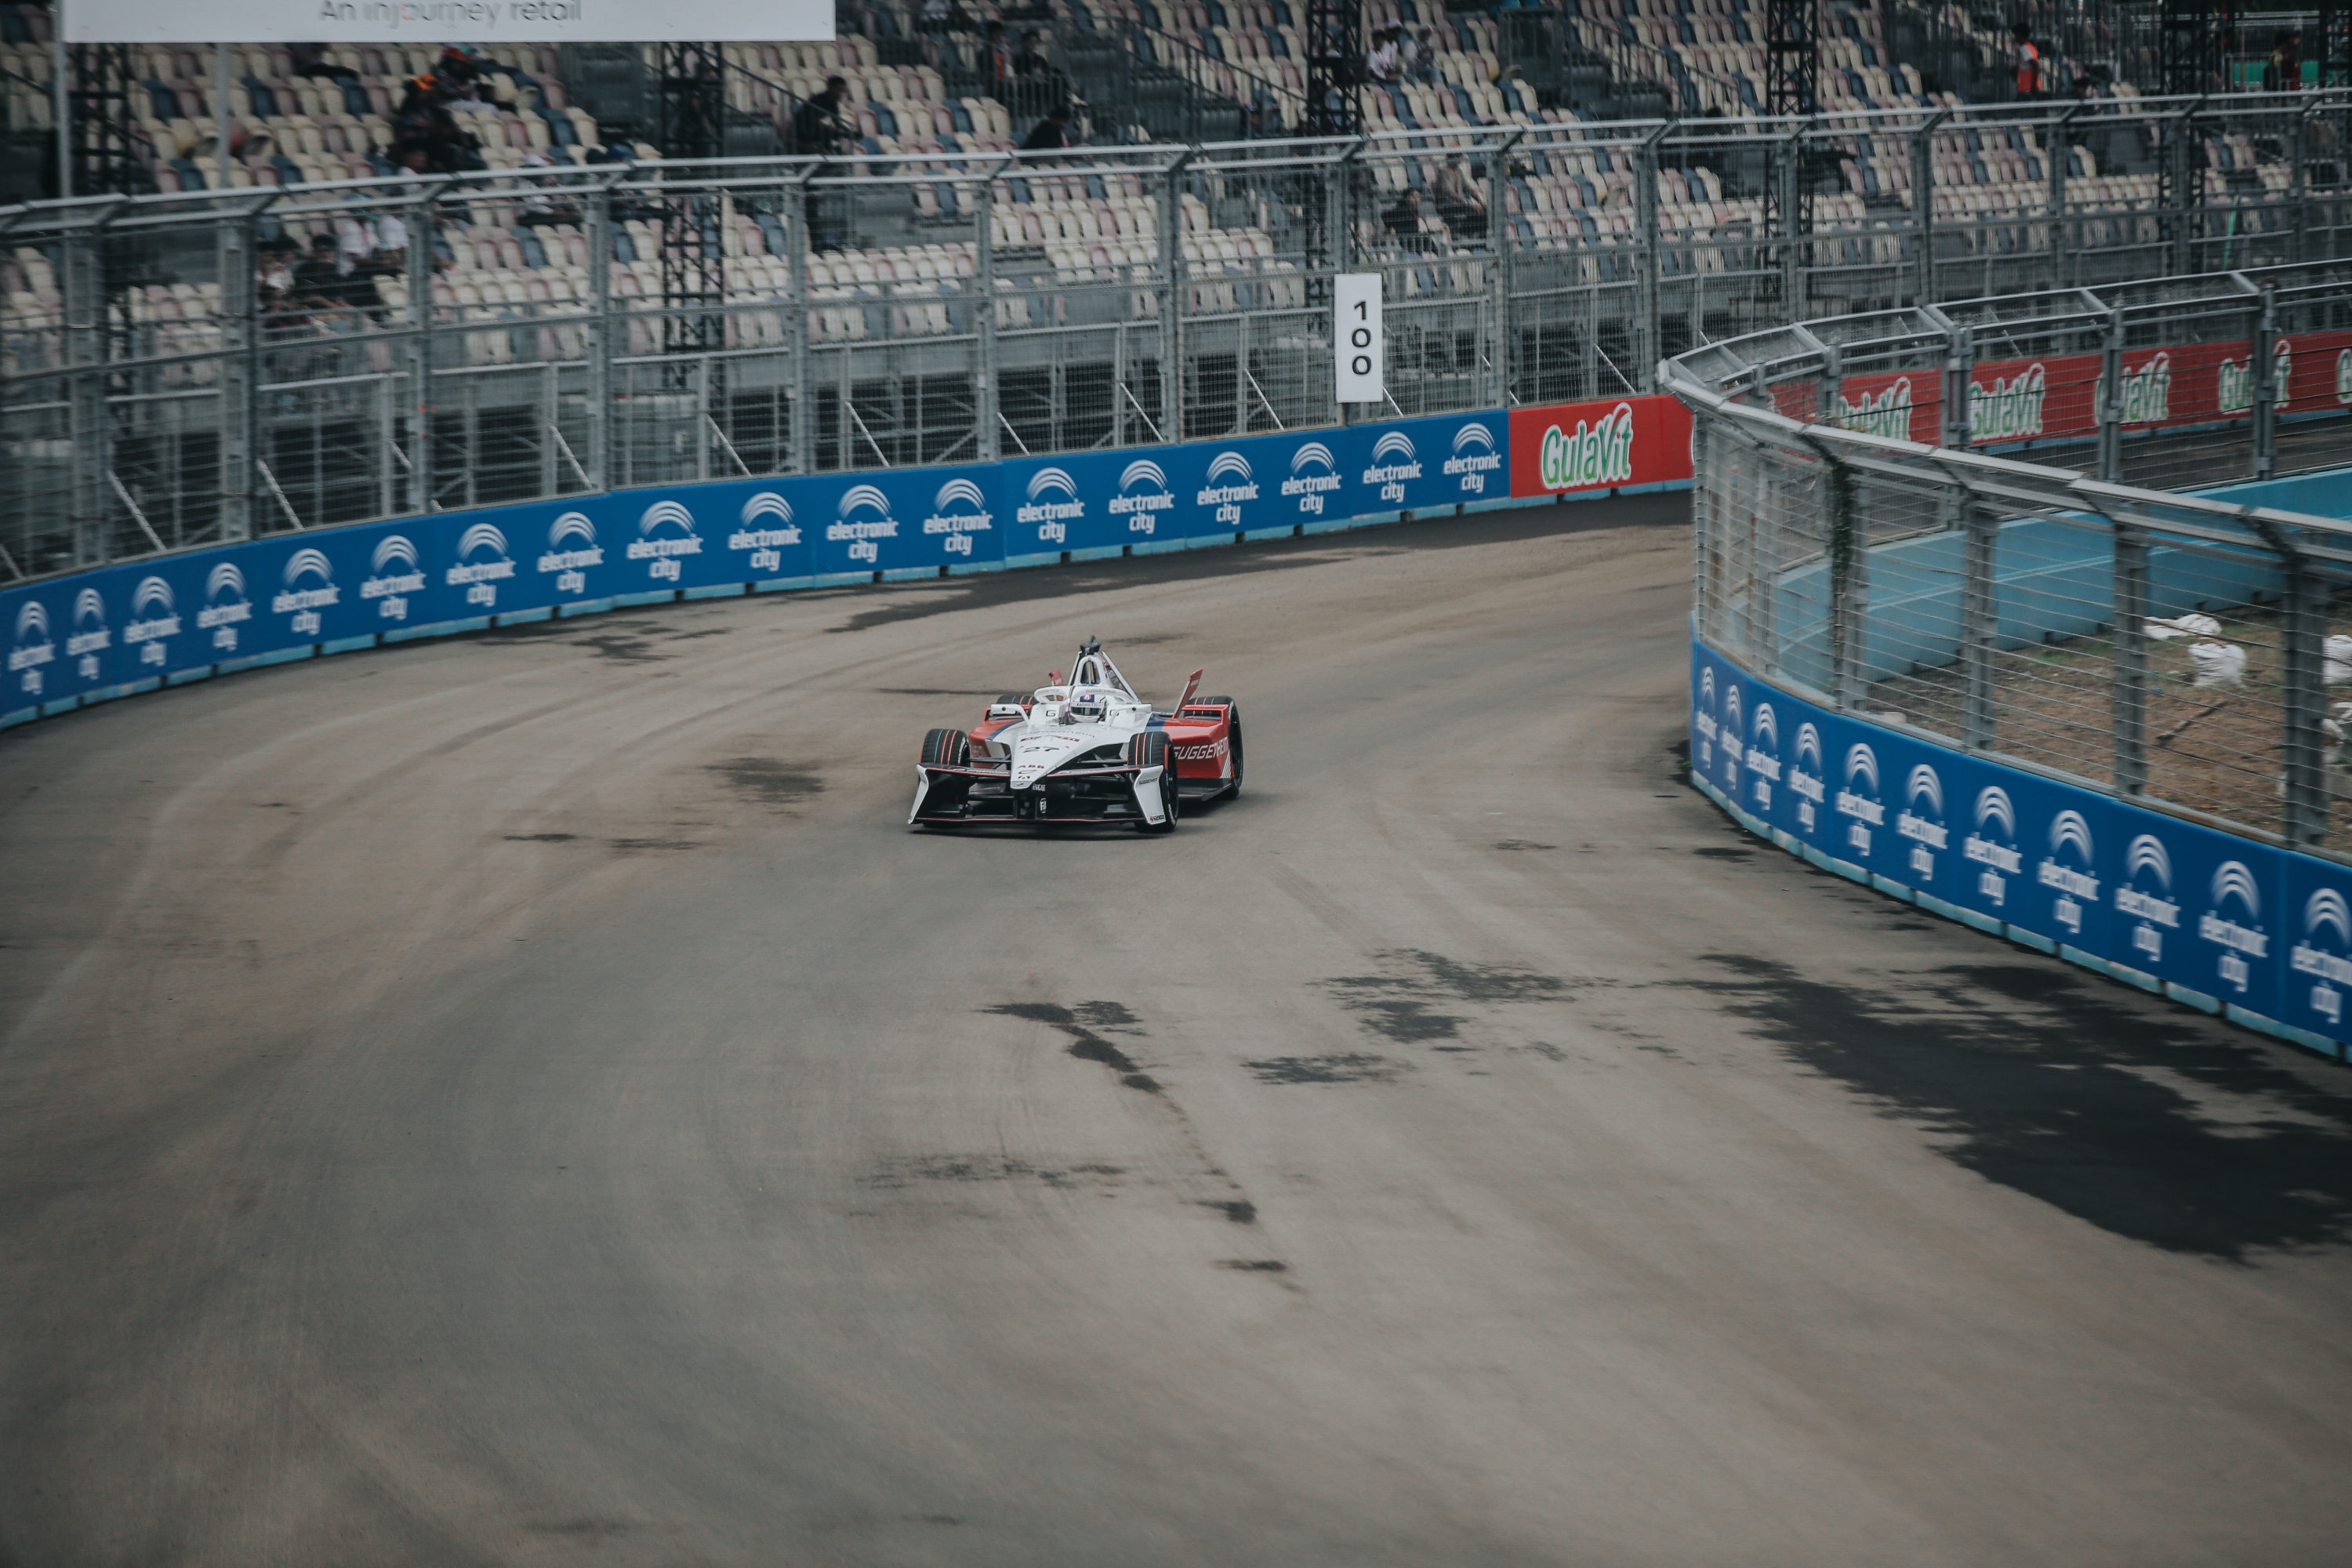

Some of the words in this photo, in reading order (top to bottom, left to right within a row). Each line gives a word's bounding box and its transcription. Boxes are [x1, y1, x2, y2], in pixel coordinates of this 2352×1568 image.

[318, 0, 354, 21] An
[510, 0, 583, 22] retail
[1351, 300, 1372, 376] 100
[1541, 401, 1634, 490] GulaVit
[1363, 459, 1423, 485] electronic
[1443, 451, 1502, 474] electronic
[1196, 481, 1259, 506] electronic
[1281, 471, 1342, 495] electronic
[1381, 481, 1405, 503] city
[1461, 472, 1485, 494] city
[1017, 496, 1085, 523] electronic
[1109, 488, 1175, 514] electronic
[1215, 501, 1241, 525] city
[1299, 493, 1323, 515] city
[826, 515, 899, 541] electronic
[924, 509, 994, 534] electronic
[1038, 518, 1065, 544] city
[1129, 510, 1156, 535] city
[626, 532, 703, 560] electronic
[728, 522, 802, 550] electronic
[944, 530, 973, 556] city
[537, 543, 604, 573] electronic
[750, 546, 781, 572] city
[848, 537, 878, 563] city
[446, 555, 516, 586] electronic
[557, 568, 586, 594] city
[649, 555, 681, 582] city
